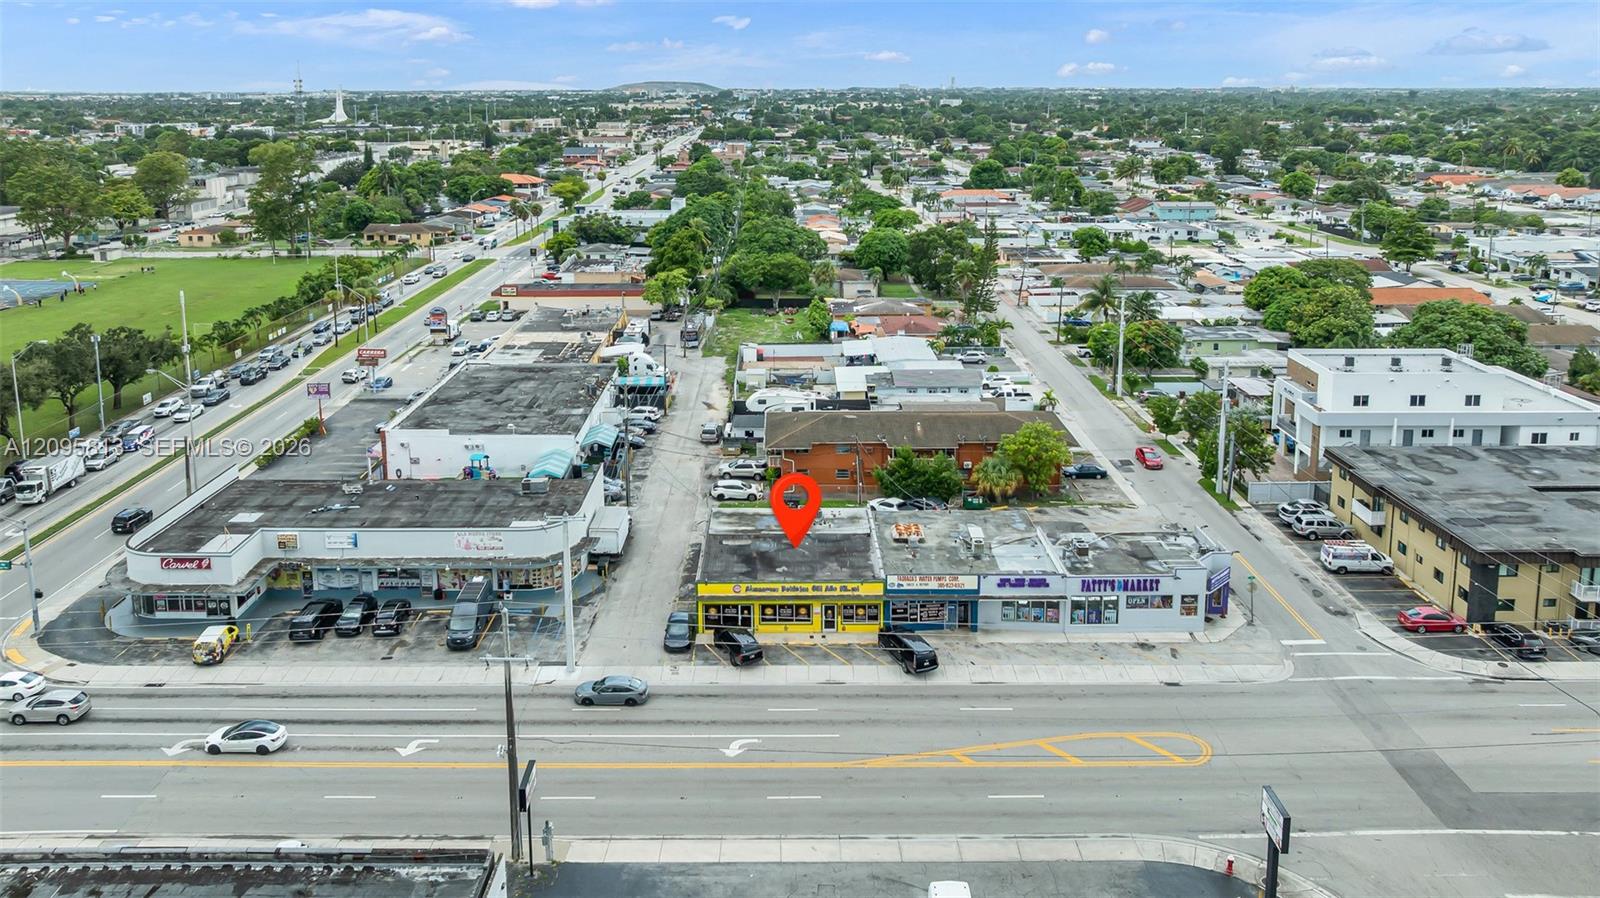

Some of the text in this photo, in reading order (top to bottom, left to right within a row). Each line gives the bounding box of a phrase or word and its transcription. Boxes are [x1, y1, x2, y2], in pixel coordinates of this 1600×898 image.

[162, 558, 200, 569] Carvel
[1081, 579, 1160, 592] FATTY'S MARKET
